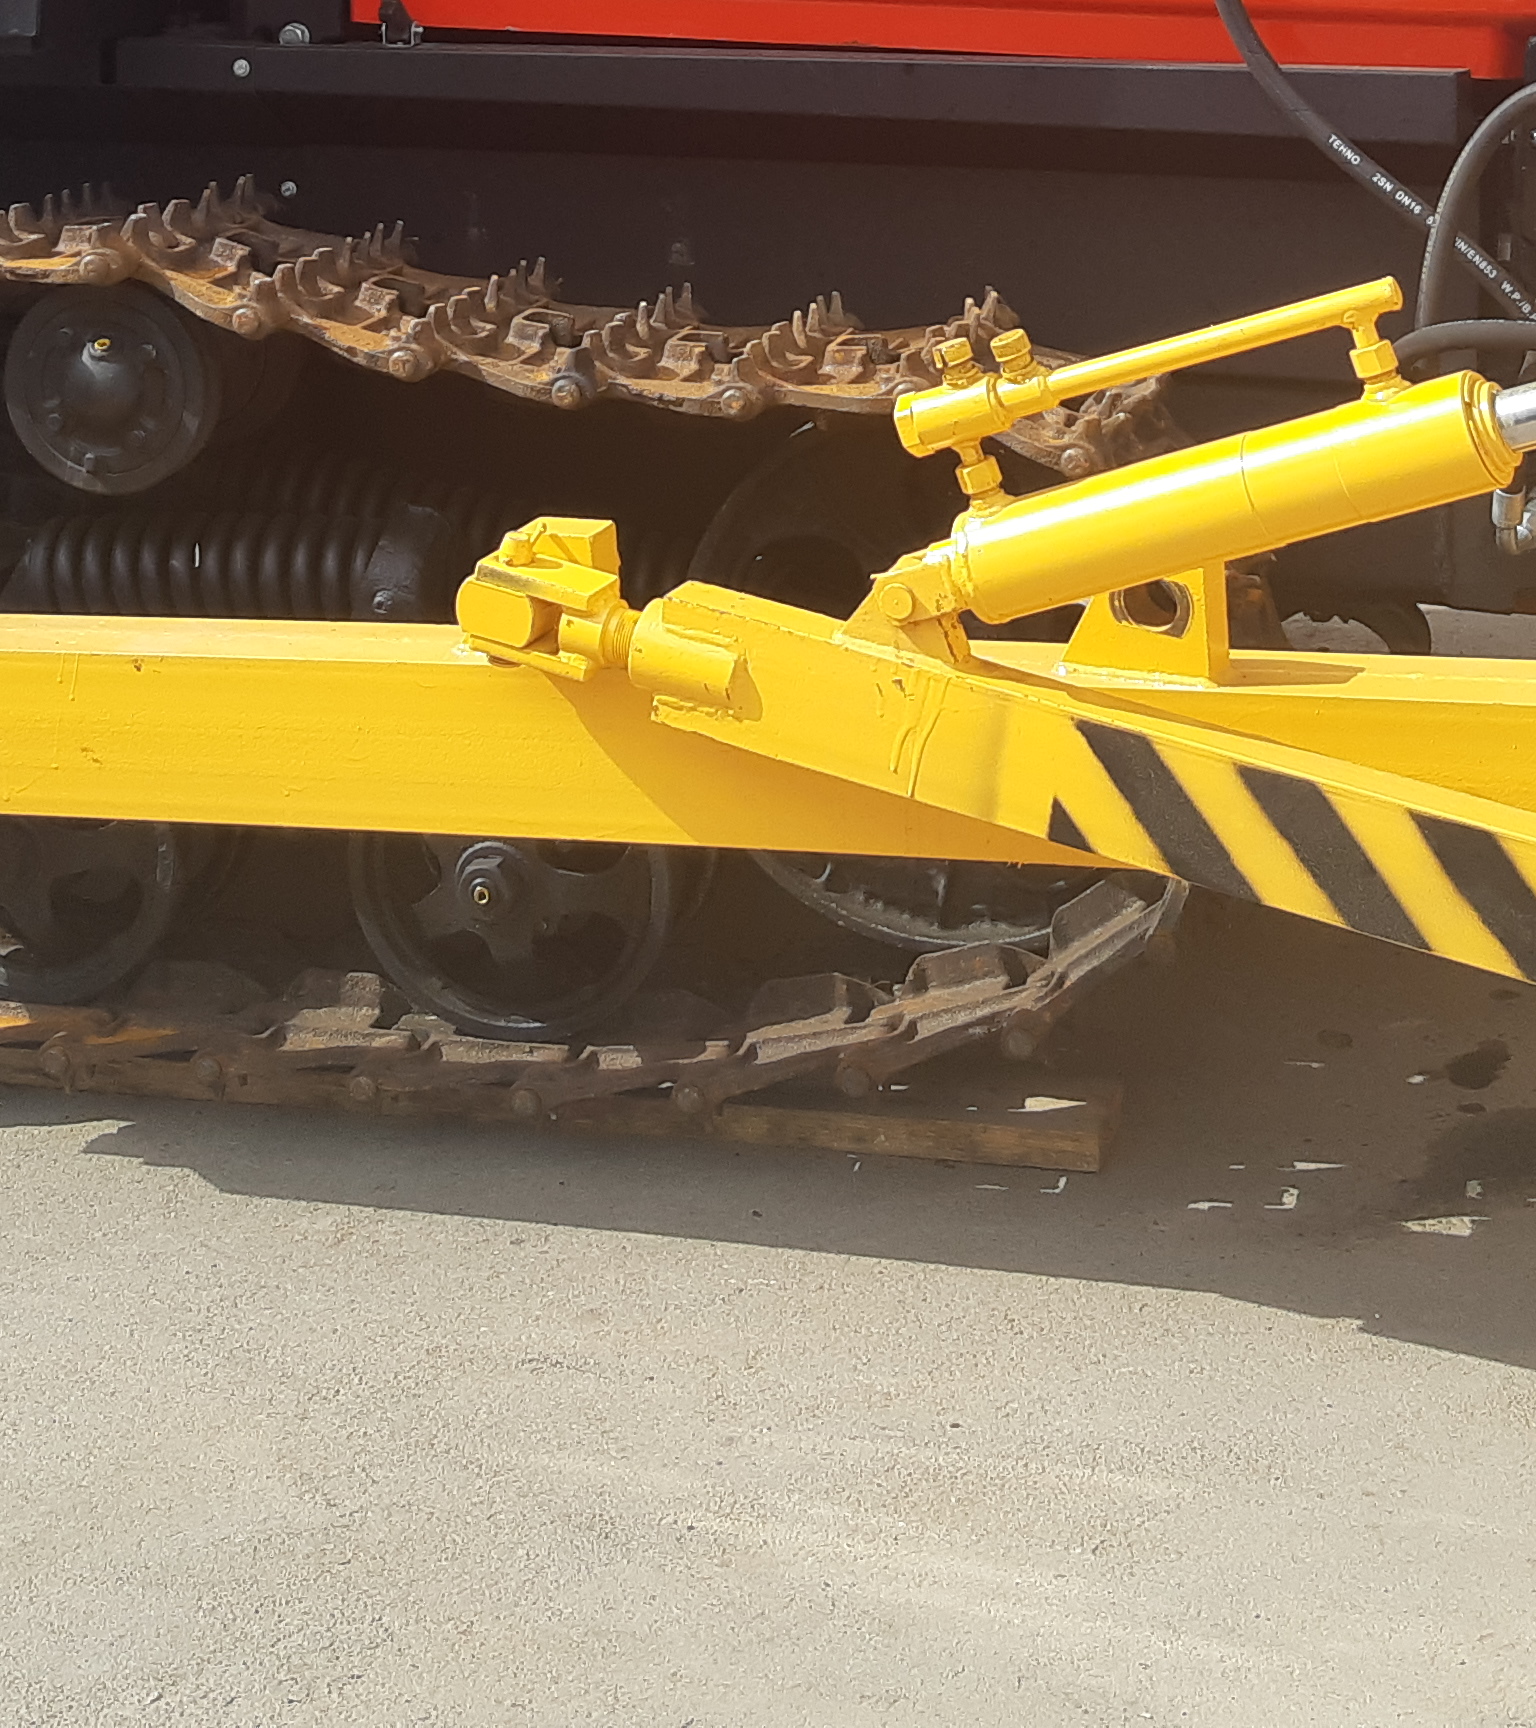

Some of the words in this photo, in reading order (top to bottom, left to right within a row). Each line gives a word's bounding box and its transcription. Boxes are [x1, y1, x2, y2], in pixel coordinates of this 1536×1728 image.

[1328, 133, 1362, 166] TEHNO
[1371, 172, 1394, 193] 2SN
[1394, 190, 1423, 215] DN16
[1454, 236, 1498, 279] IN/EN853
